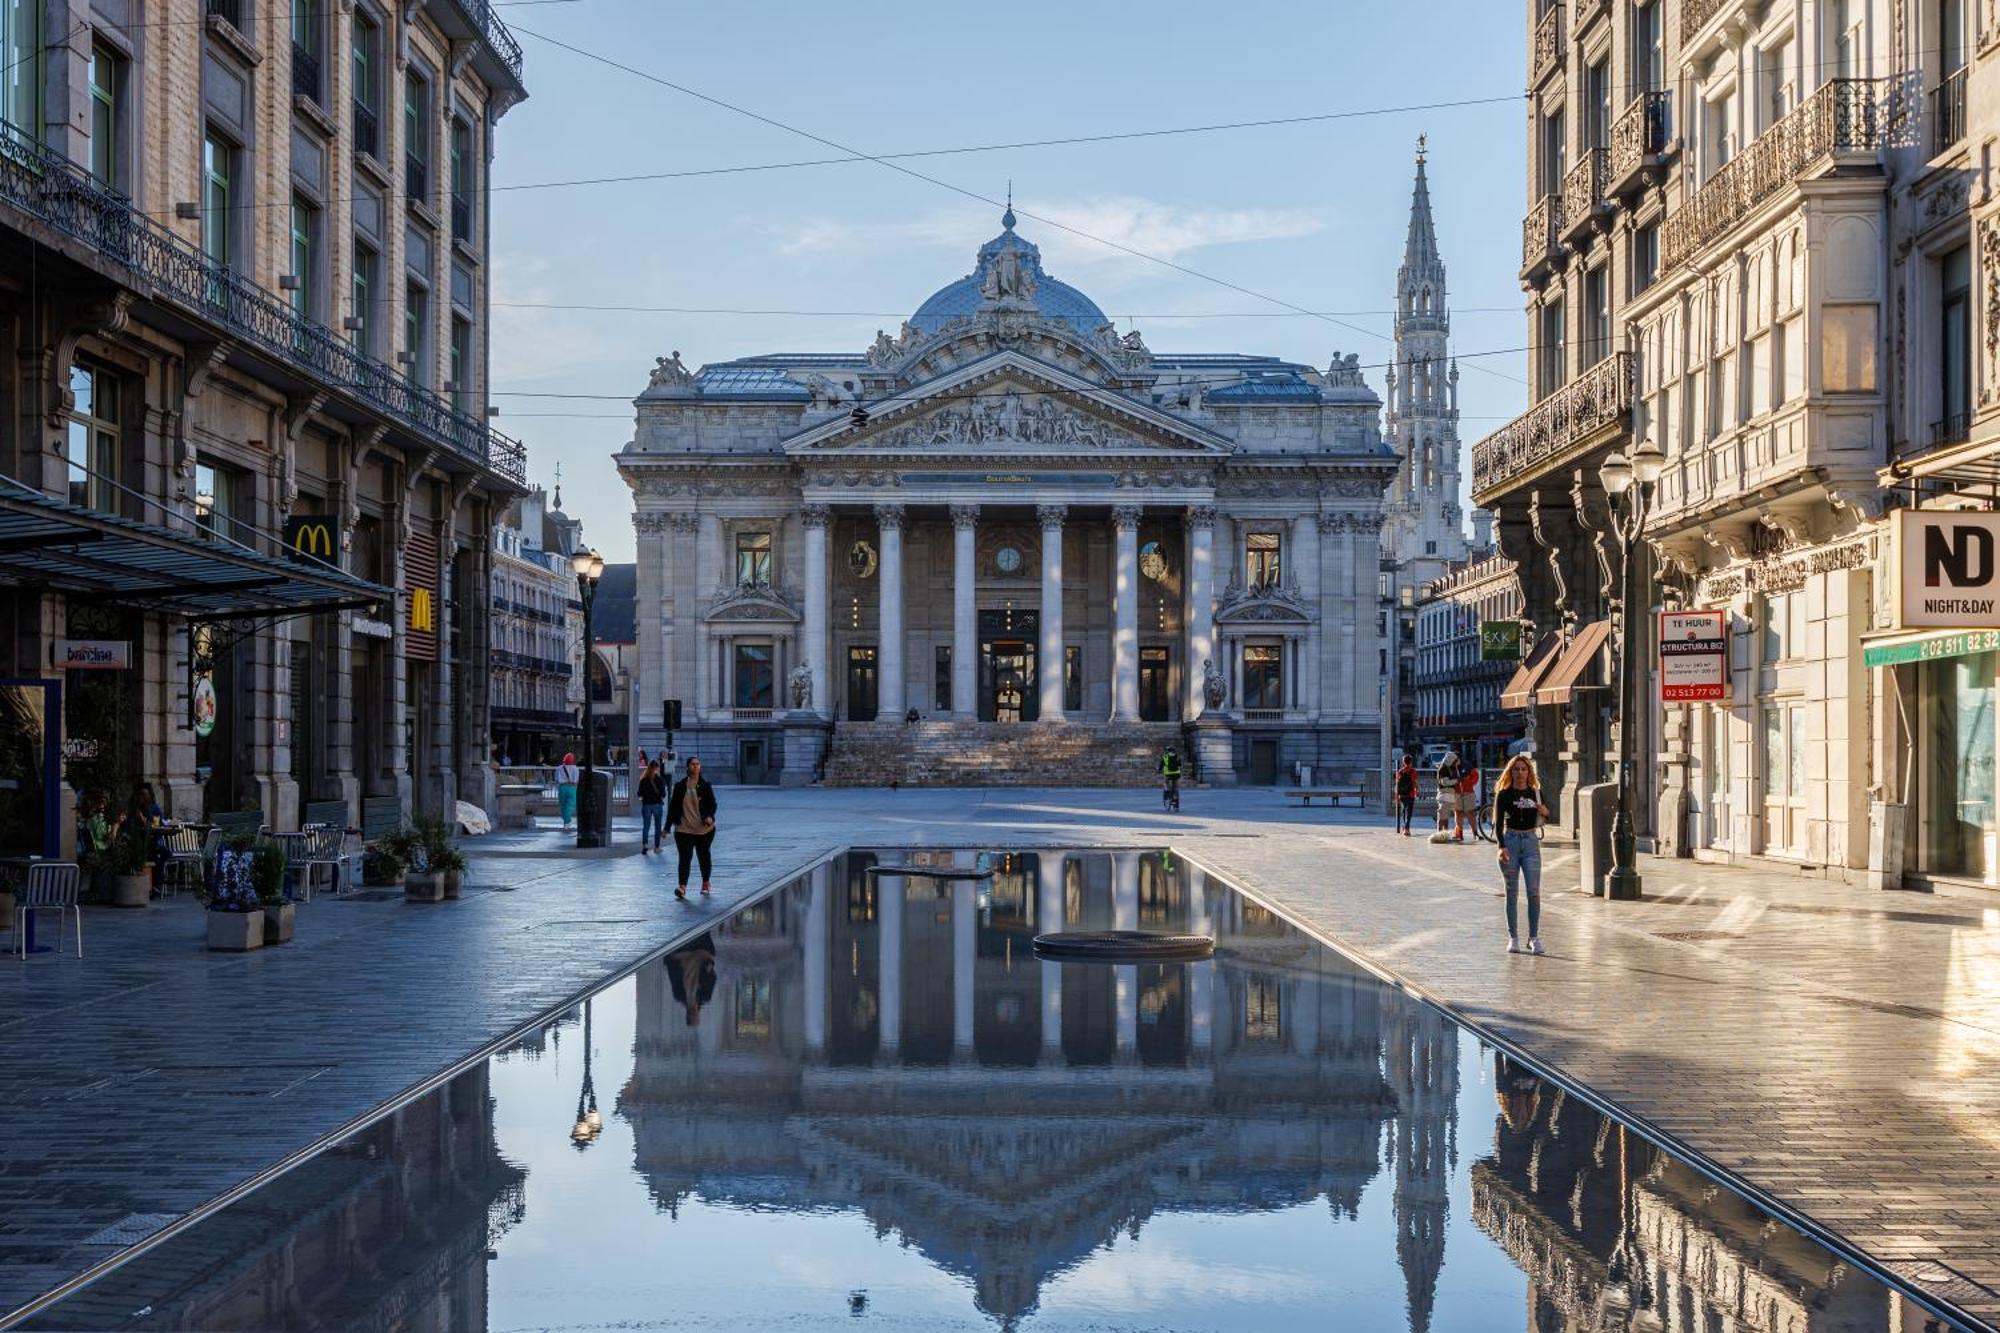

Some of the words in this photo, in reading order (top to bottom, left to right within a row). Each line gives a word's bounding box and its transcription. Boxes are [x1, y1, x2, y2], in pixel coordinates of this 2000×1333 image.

[1925, 525, 1994, 587] ND
[1925, 599, 1994, 614] NIGHT&DAY
[1673, 620, 1682, 628] TE
[1686, 619, 1712, 627] HUUR
[1662, 642, 1723, 651] STRUCTURA.BIZ
[1929, 641, 1942, 657] 02
[1945, 638, 1963, 653] 511
[1983, 631, 1999, 647] 32
[1679, 689, 1694, 697] 513
[1709, 688, 1720, 696] 00
